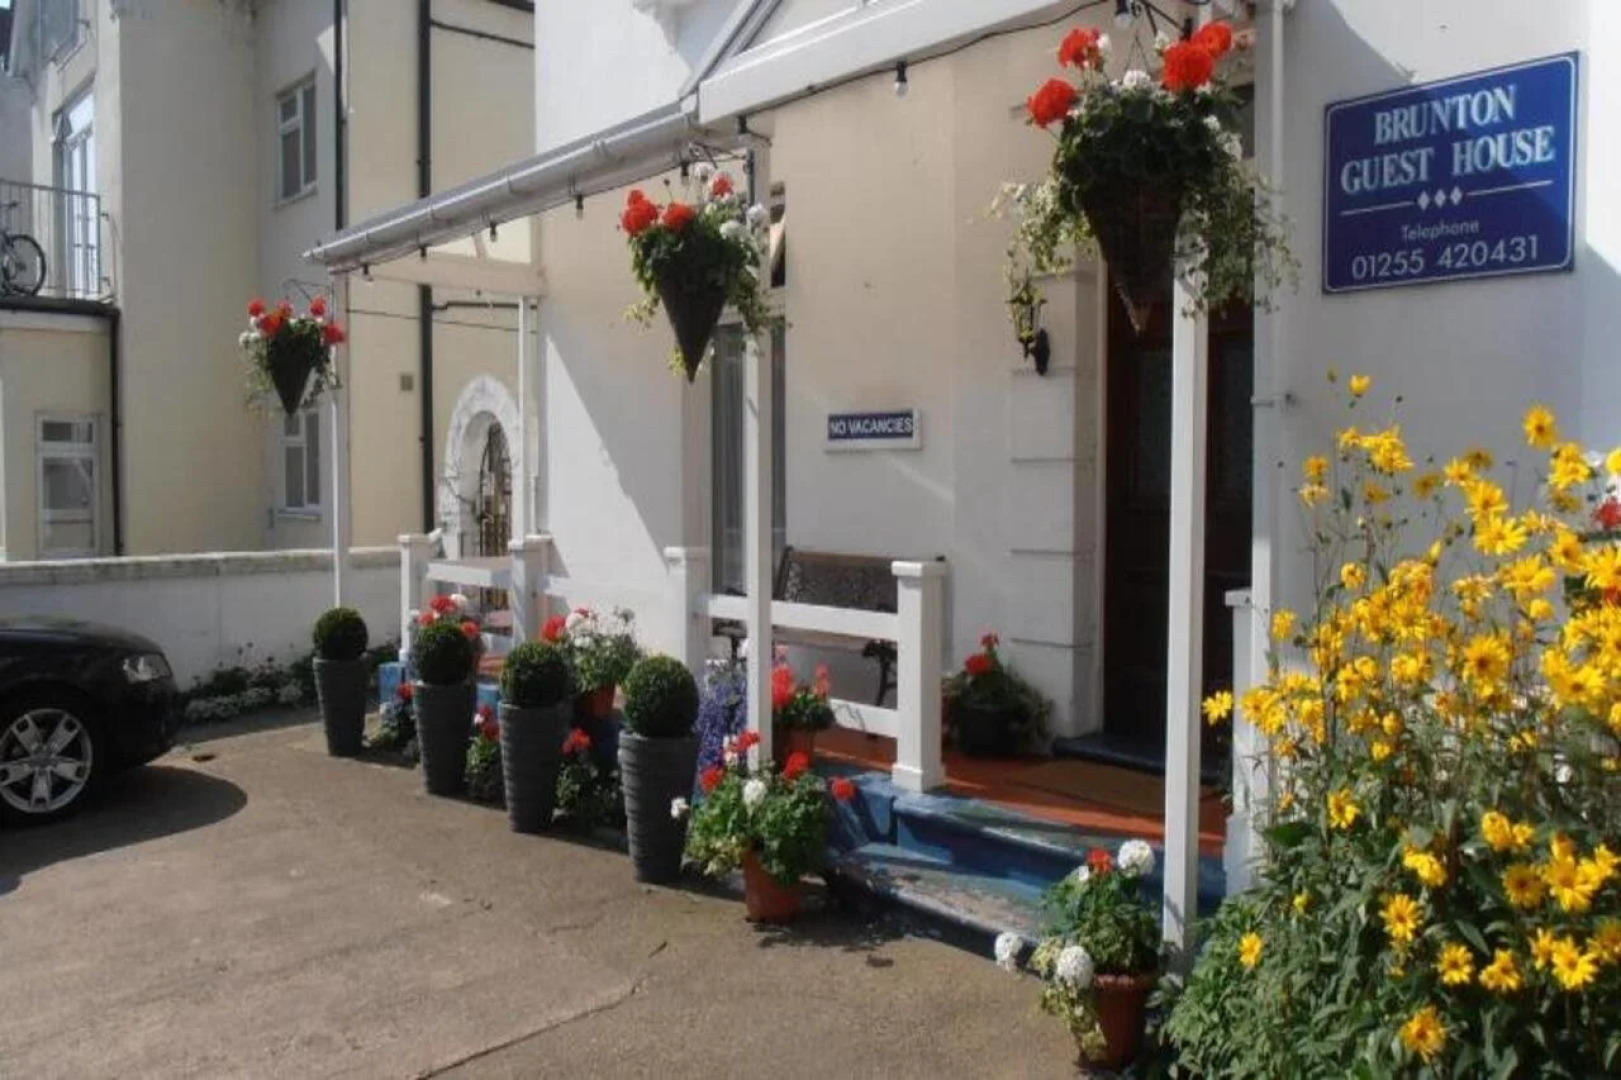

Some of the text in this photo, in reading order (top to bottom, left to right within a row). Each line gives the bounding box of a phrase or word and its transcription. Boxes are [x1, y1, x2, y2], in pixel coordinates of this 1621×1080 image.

[1374, 83, 1517, 146] BRUNTON
[1340, 125, 1556, 195] GUEST HOUSE
[1401, 219, 1480, 242] Telephone
[1352, 234, 1538, 280] 01255 420431
[830, 417, 913, 435] NO VACANCIES
